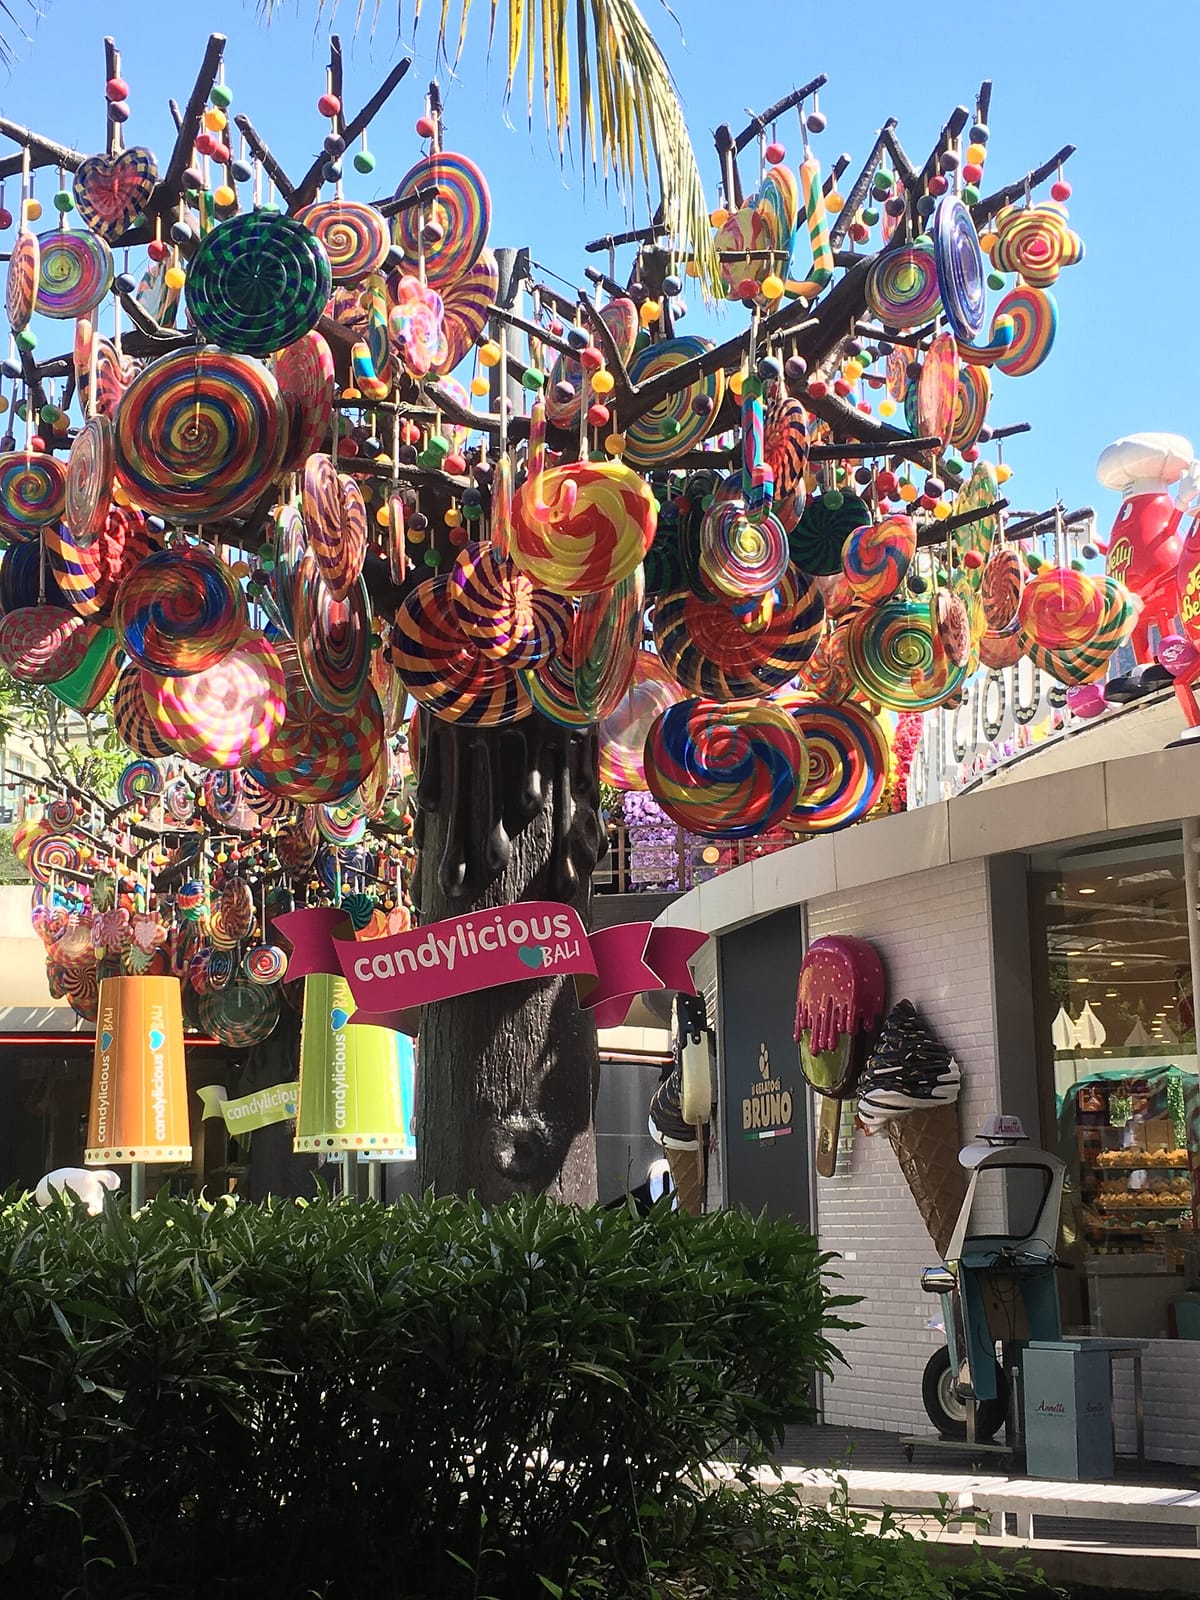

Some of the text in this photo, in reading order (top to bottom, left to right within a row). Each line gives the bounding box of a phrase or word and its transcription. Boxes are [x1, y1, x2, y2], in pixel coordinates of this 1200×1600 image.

[353, 914, 572, 982] candylicious
[541, 940, 580, 968] BALI
[97, 1007, 114, 1143] candylicious BALI
[151, 1005, 167, 1142] candylicious BALI
[332, 982, 349, 1129] candylicious BALI
[226, 1088, 297, 1120] candyliciou
[742, 1091, 792, 1129] BRUNO
